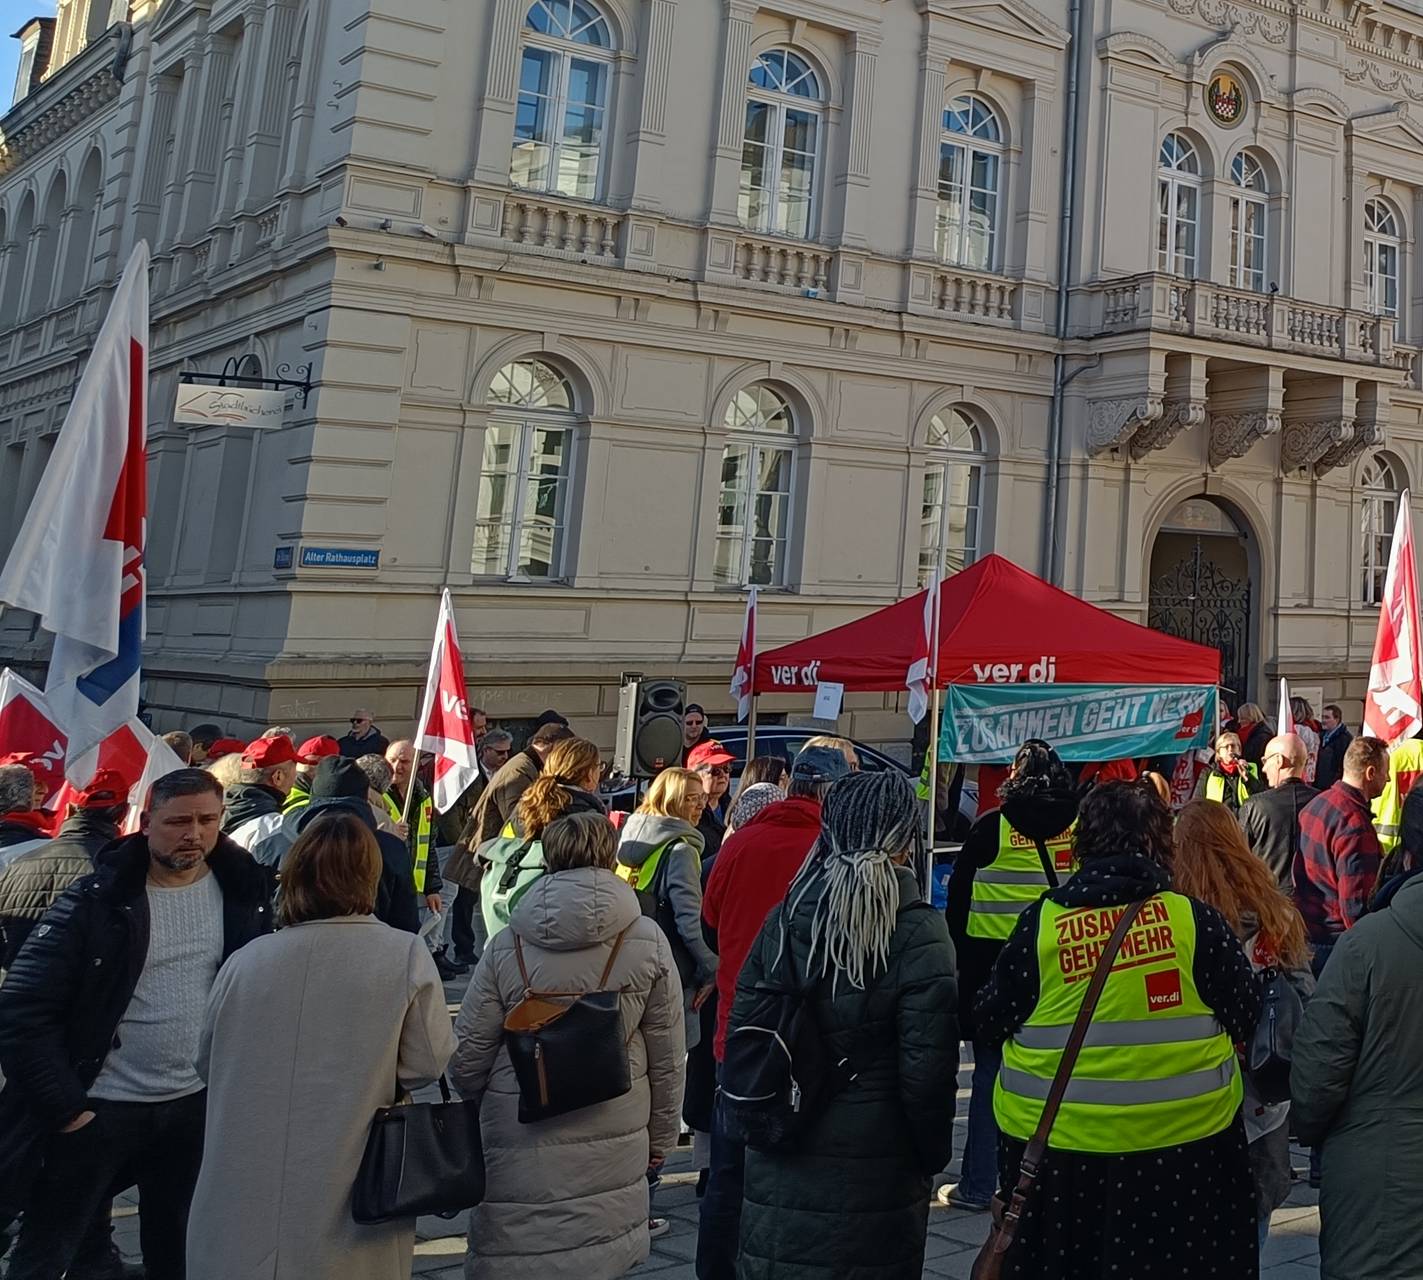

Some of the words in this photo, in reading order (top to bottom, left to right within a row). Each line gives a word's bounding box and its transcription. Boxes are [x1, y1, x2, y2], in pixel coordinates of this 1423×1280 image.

[304, 551, 325, 562] Alter
[326, 552, 376, 565] Rathausplatz
[956, 700, 1076, 753] ZUSAMMEN
[1082, 696, 1146, 730] GEHT
[1120, 925, 1176, 960] MEHR
[1150, 991, 1180, 1004] ver.di
